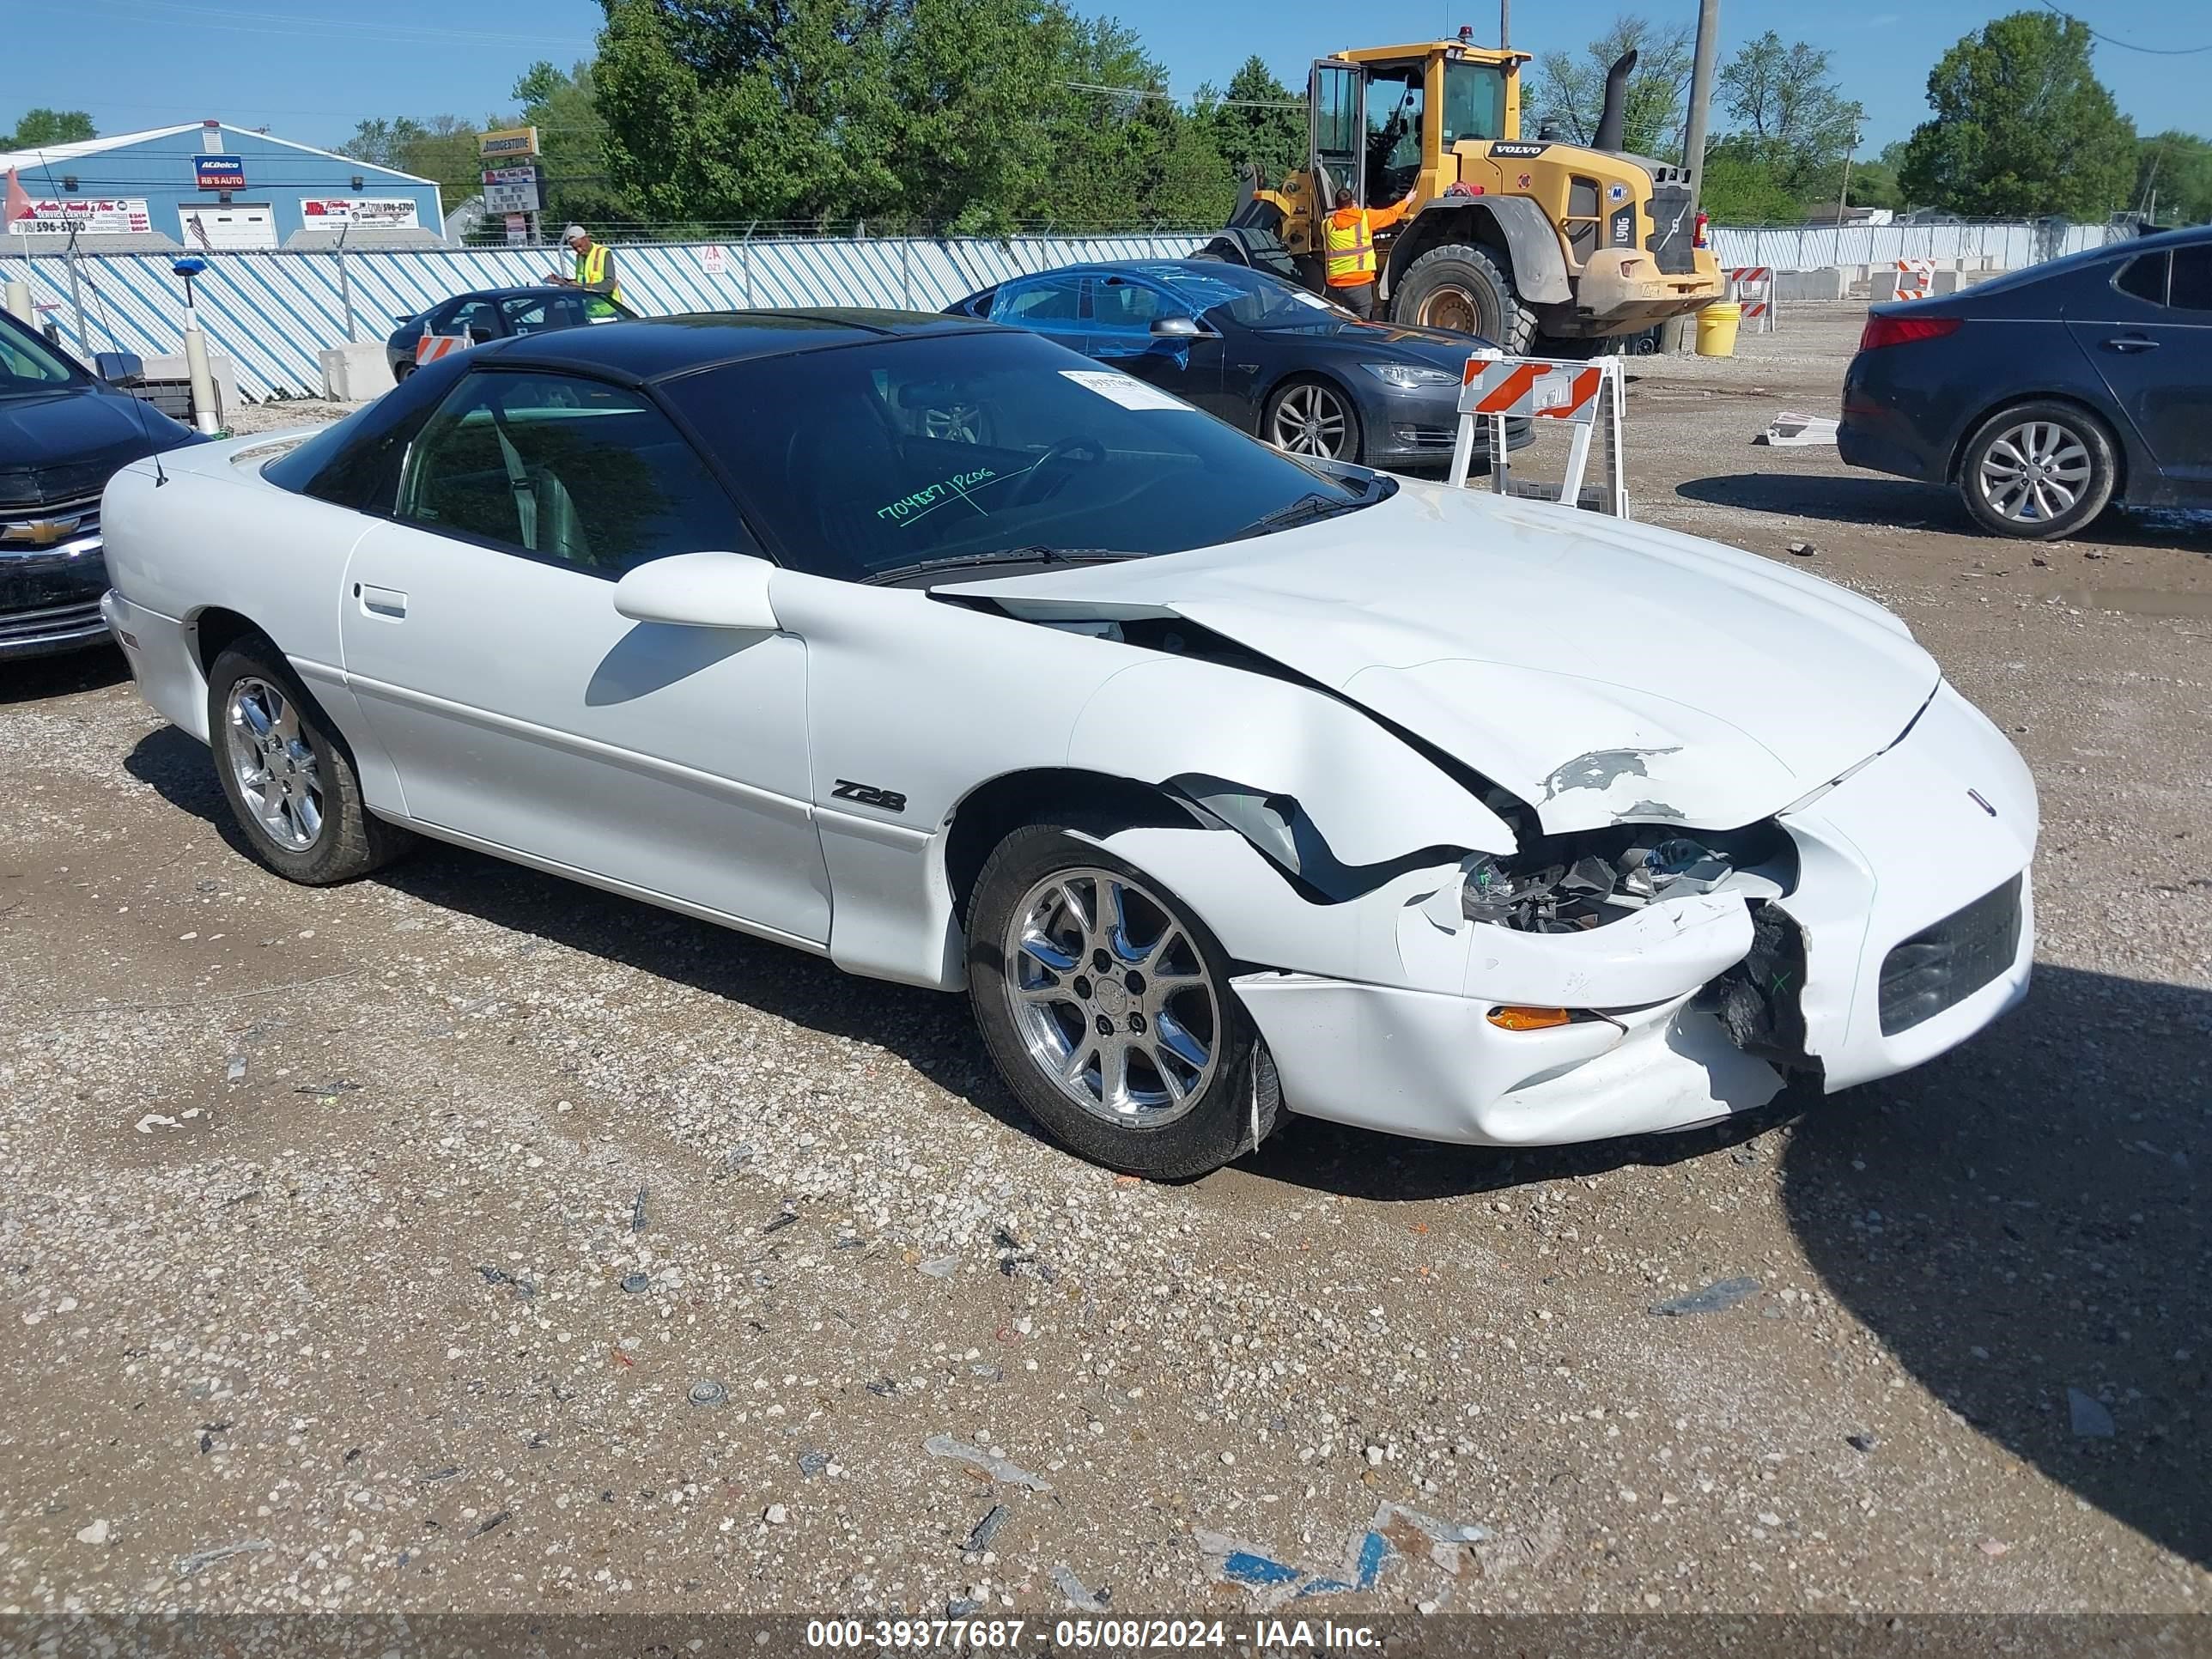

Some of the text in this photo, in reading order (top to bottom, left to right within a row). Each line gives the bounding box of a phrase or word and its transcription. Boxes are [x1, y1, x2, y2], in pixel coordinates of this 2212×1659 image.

[1495, 145, 1542, 154] VOLVO
[1615, 217, 1630, 242] L90G
[877, 484, 945, 520] 704837
[831, 778, 907, 814] Z28
